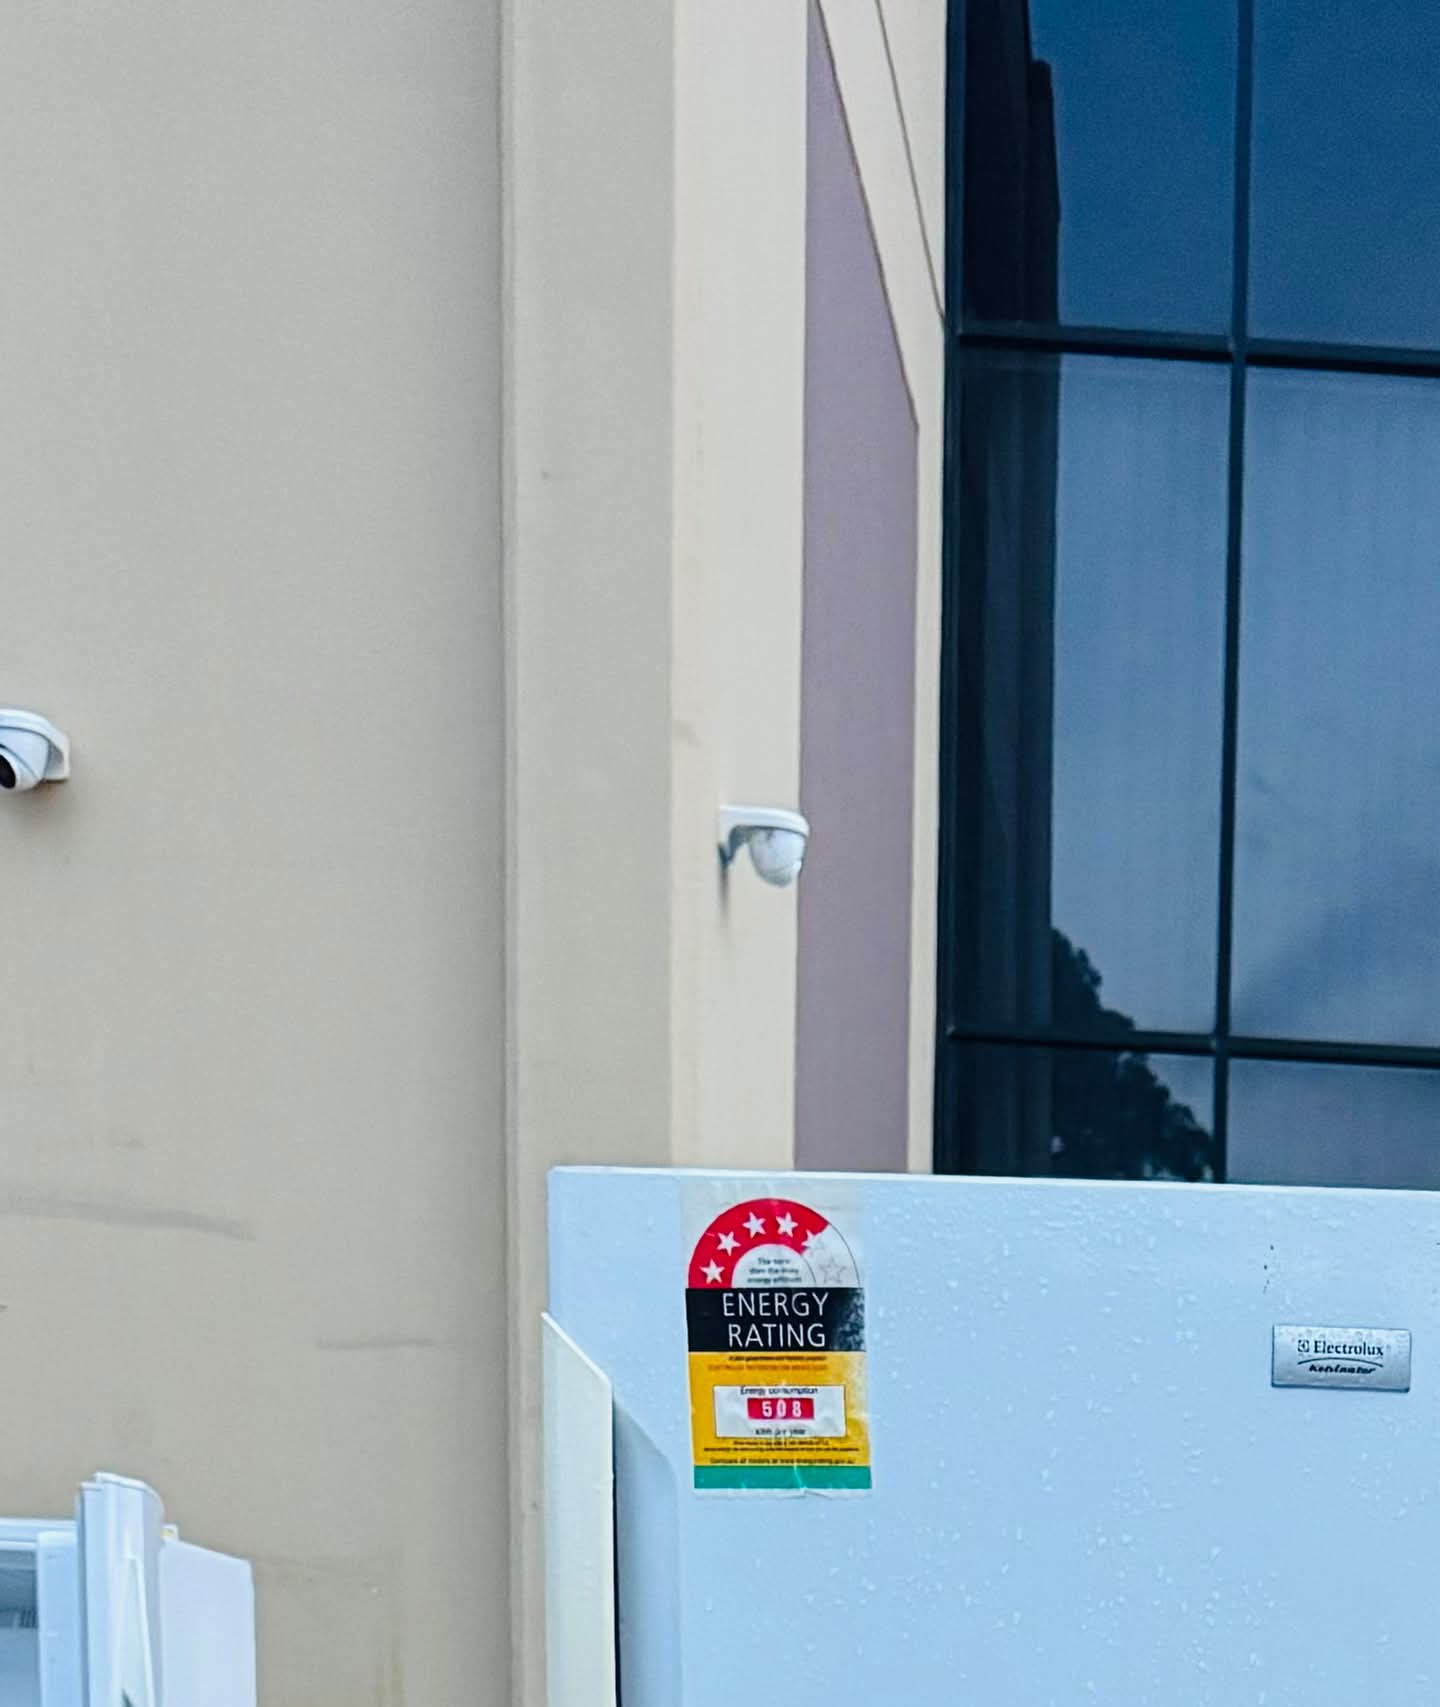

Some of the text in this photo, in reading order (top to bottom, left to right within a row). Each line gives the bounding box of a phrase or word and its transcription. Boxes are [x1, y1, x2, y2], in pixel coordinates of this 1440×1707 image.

[722, 1291, 829, 1317] ENERGY
[727, 1322, 826, 1348] RATING
[1313, 1340, 1384, 1356] Electrolux
[761, 1399, 802, 1418] 508
